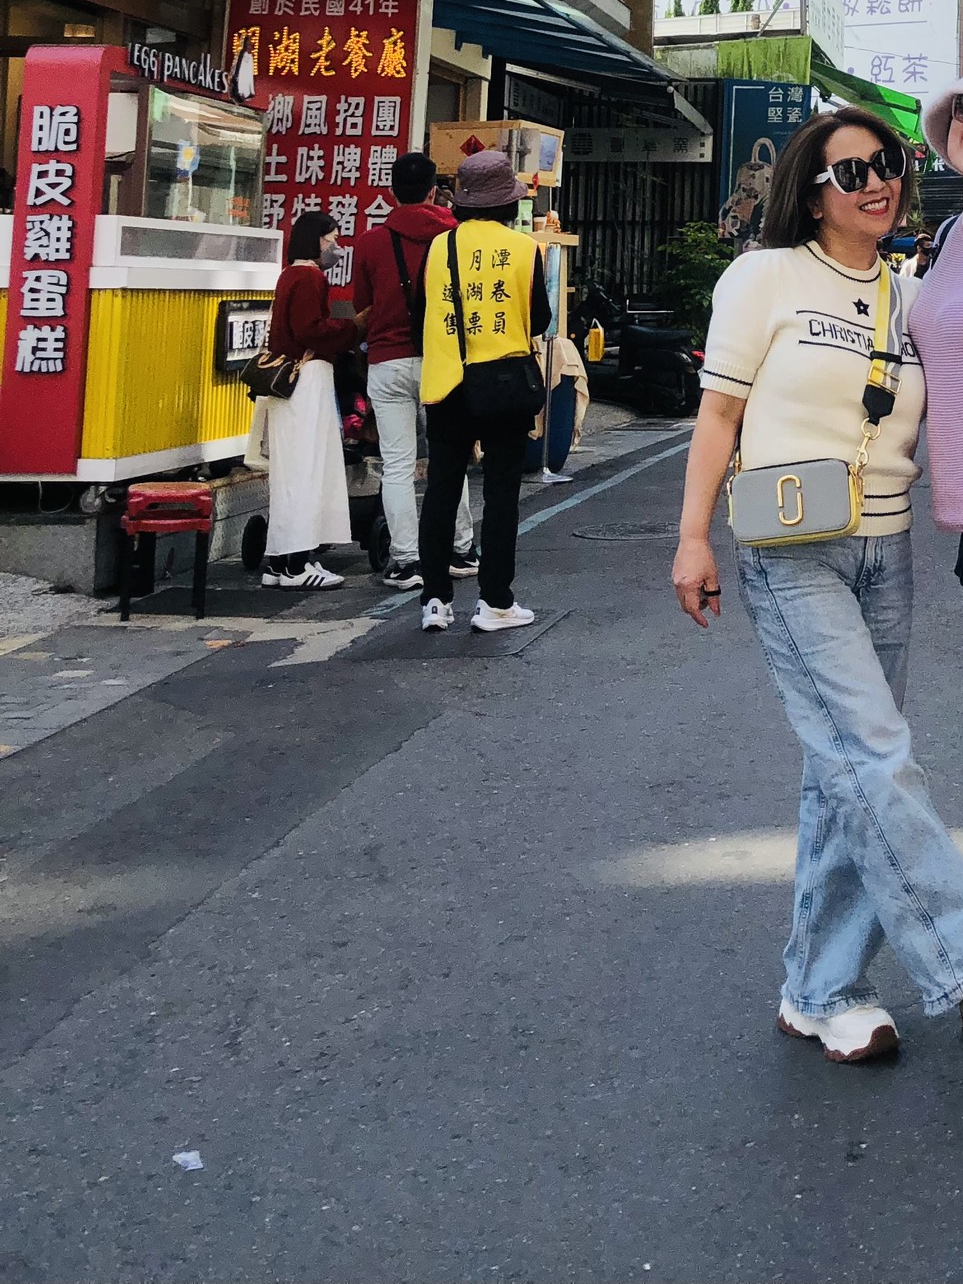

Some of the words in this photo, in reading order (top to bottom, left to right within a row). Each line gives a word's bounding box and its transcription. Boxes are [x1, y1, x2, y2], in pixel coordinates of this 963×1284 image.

[134, 43, 158, 80] EGG
[164, 52, 229, 94] PANCAKES
[870, 52, 929, 84] 紅茶
[768, 86, 804, 103] 台灣
[767, 107, 804, 124] 堅瓷
[15, 104, 79, 374] 脆皮雞蛋糕
[466, 248, 512, 271] 月潭
[808, 318, 875, 352] CHRISTIA
